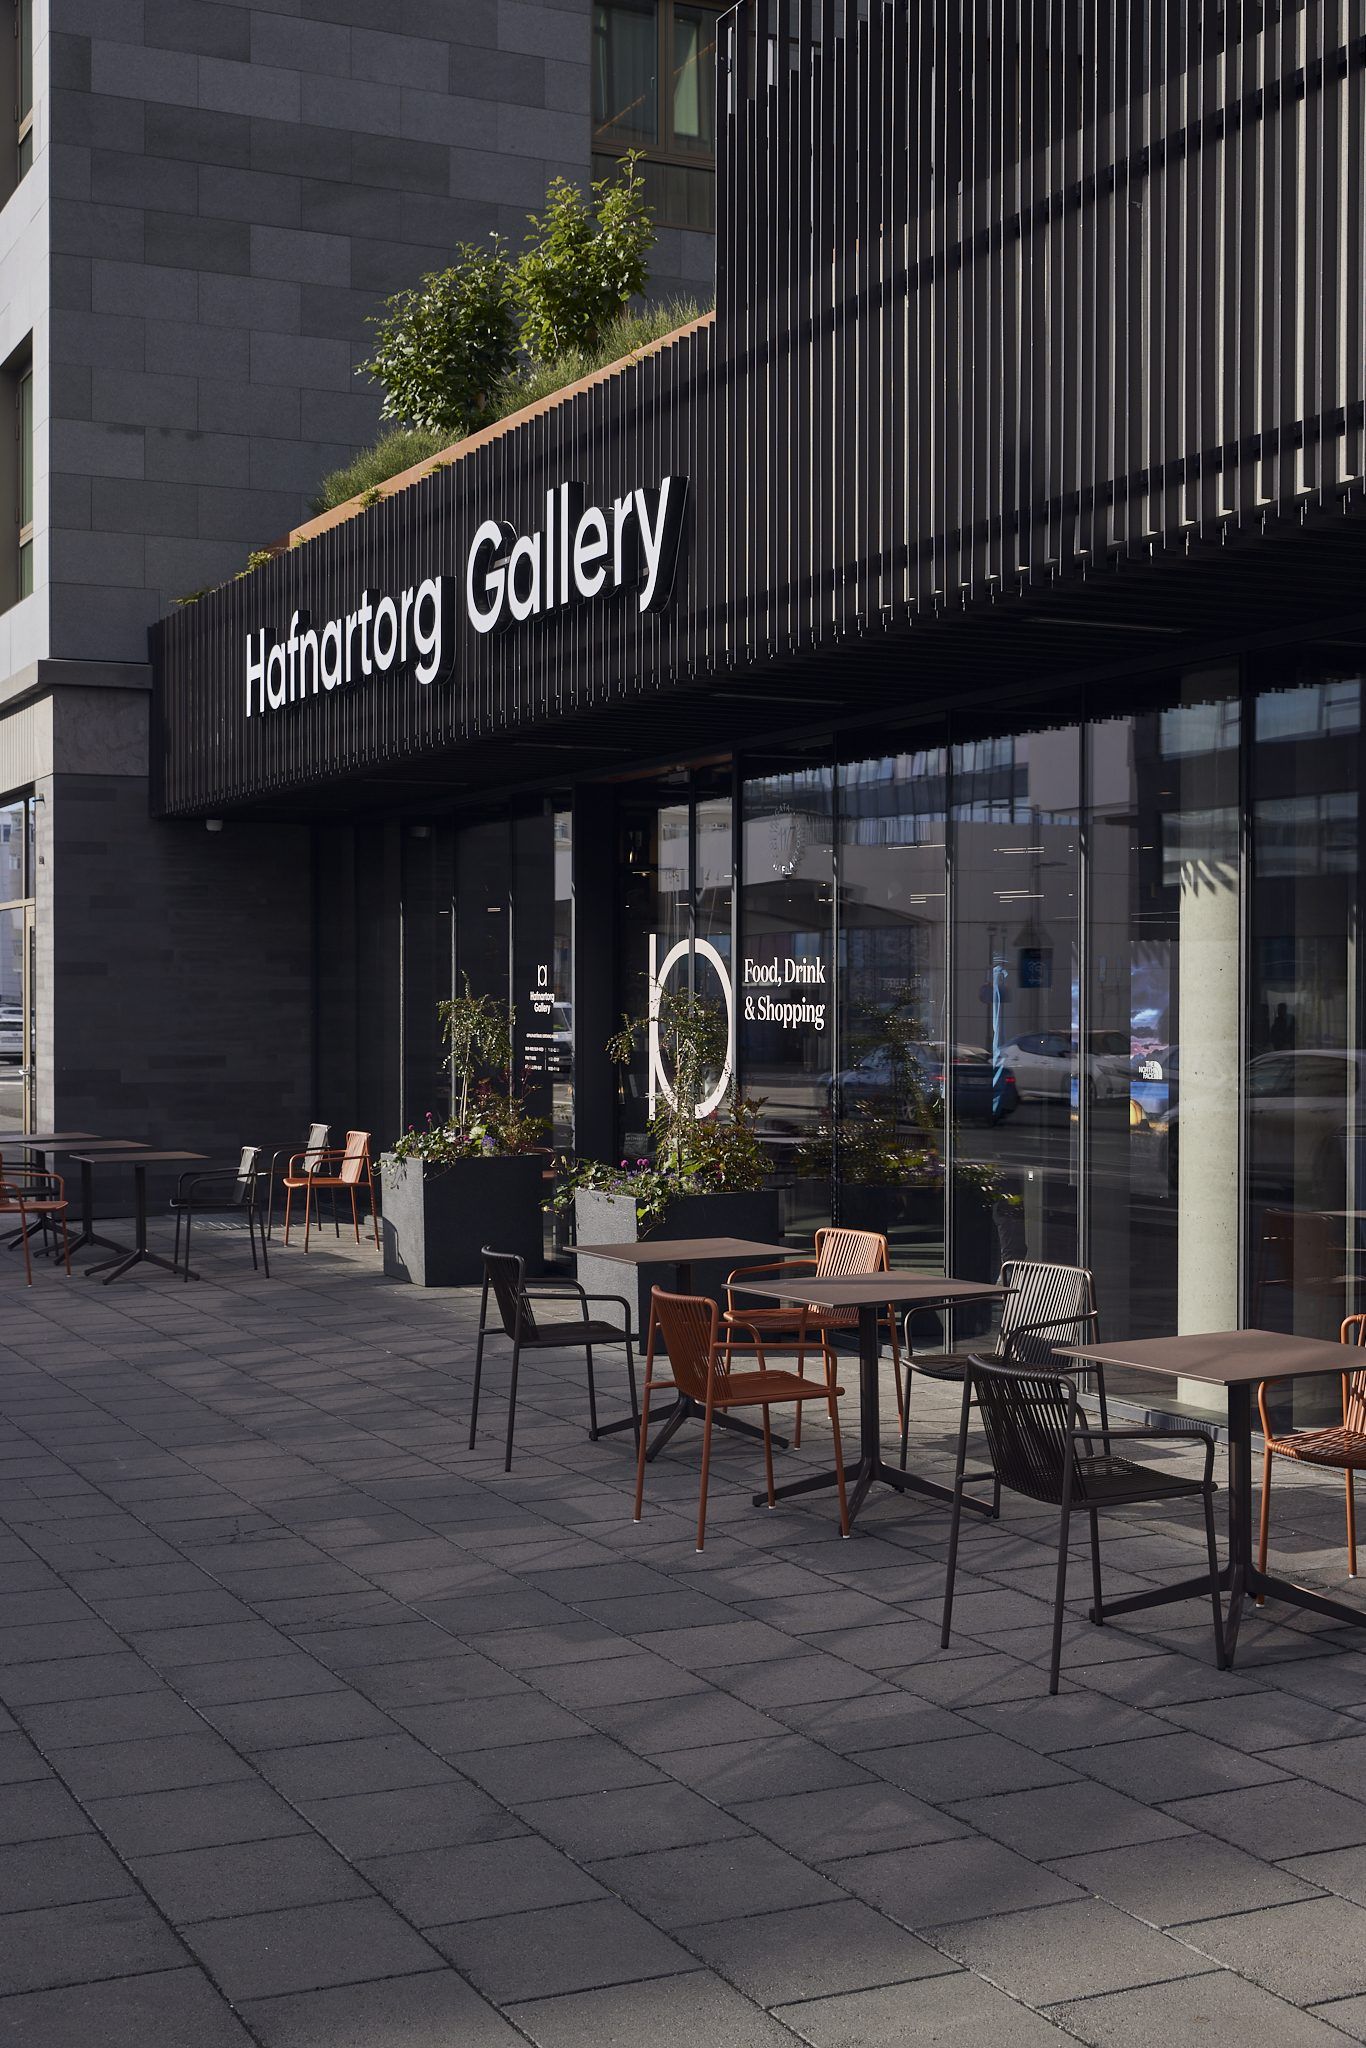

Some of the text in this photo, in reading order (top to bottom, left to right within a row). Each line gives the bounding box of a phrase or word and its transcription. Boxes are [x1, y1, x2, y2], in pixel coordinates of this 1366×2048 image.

[246, 476, 670, 717] Hafnartorg Gallery
[744, 956, 826, 987] Food, Drink
[533, 1002, 551, 1015] Gallery
[744, 995, 826, 1031] & Shopping
[1138, 1066, 1154, 1074] NORTH
